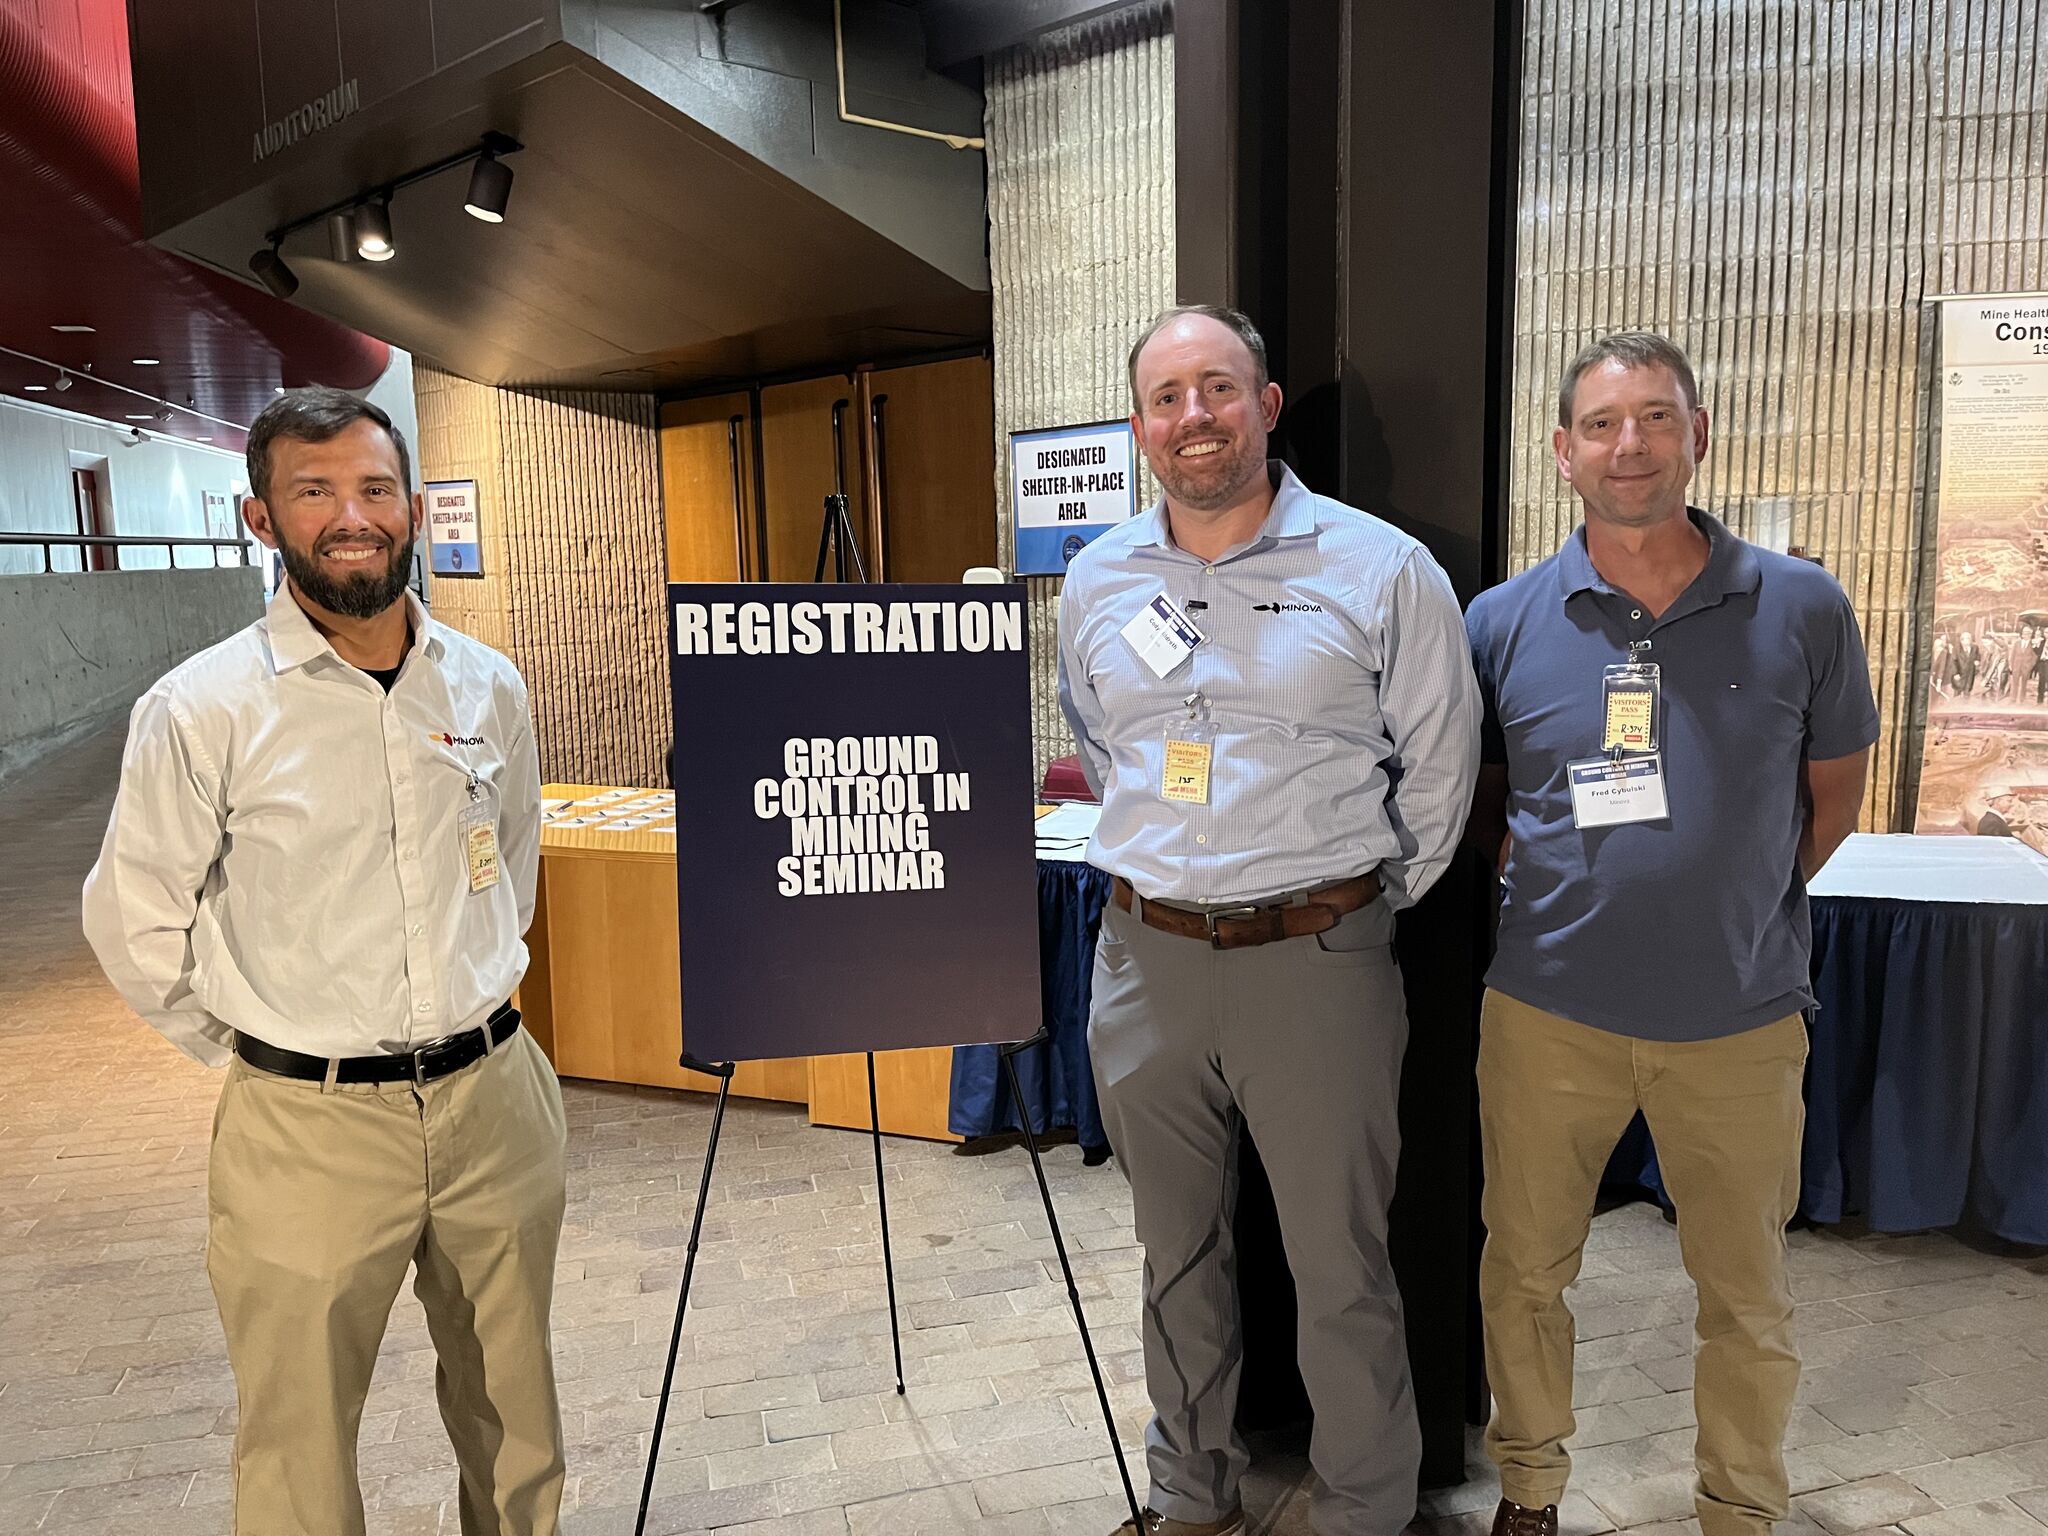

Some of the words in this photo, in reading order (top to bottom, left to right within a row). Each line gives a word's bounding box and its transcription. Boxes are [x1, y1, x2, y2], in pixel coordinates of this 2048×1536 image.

[252, 78, 360, 163] AUDITORIUM
[1981, 310, 2010, 320] Mine
[2014, 309, 2048, 319] Healt
[1037, 446, 1106, 470] DESIGNATED
[1022, 472, 1125, 497] SHELTER-IN-PLACE
[437, 496, 465, 507] DESIGNATED
[1058, 502, 1087, 520] AREA
[448, 529, 459, 539] AREA
[1281, 604, 1323, 613] MINOVA
[675, 601, 1023, 655] REGISTRATION
[784, 735, 939, 778] GROUND
[754, 774, 925, 819] CONTROL
[933, 772, 971, 812] IN
[1591, 789, 1609, 797] Fred
[1611, 785, 1646, 796] Cybulski
[791, 812, 930, 857] MINING
[777, 851, 945, 897] SEMINAR
